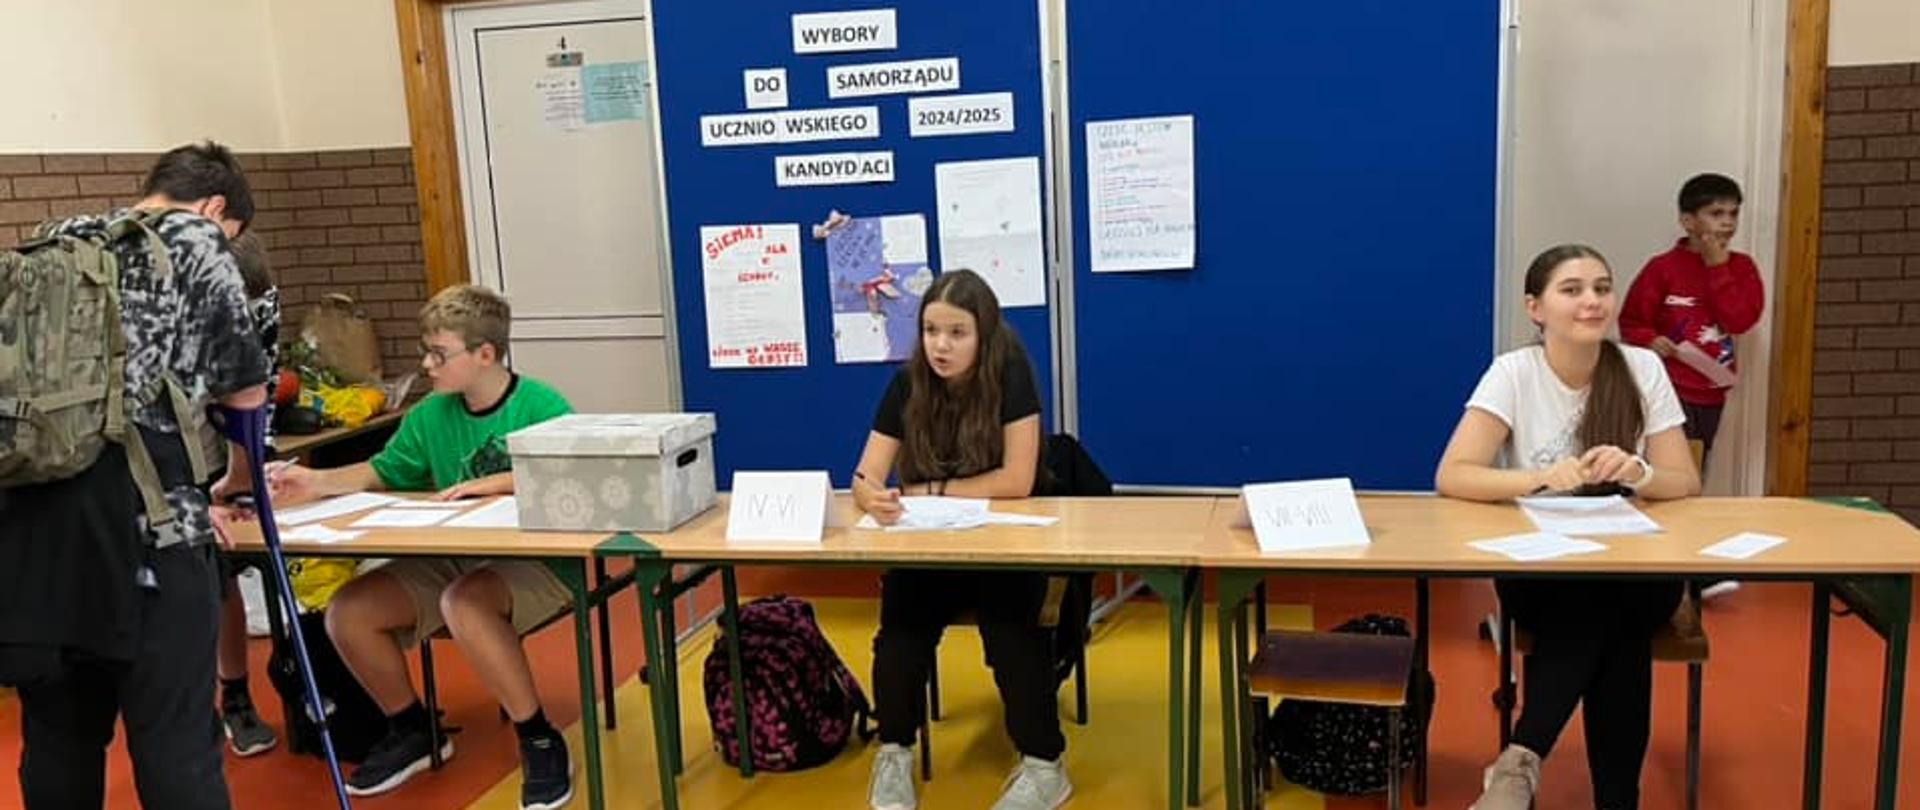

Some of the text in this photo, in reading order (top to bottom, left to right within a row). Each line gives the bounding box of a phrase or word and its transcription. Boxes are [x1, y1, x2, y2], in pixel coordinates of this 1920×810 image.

[802, 25, 880, 45] WYBORY
[753, 66, 953, 93] DO SAMORZĄDU
[918, 107, 1002, 126] 2024/2025
